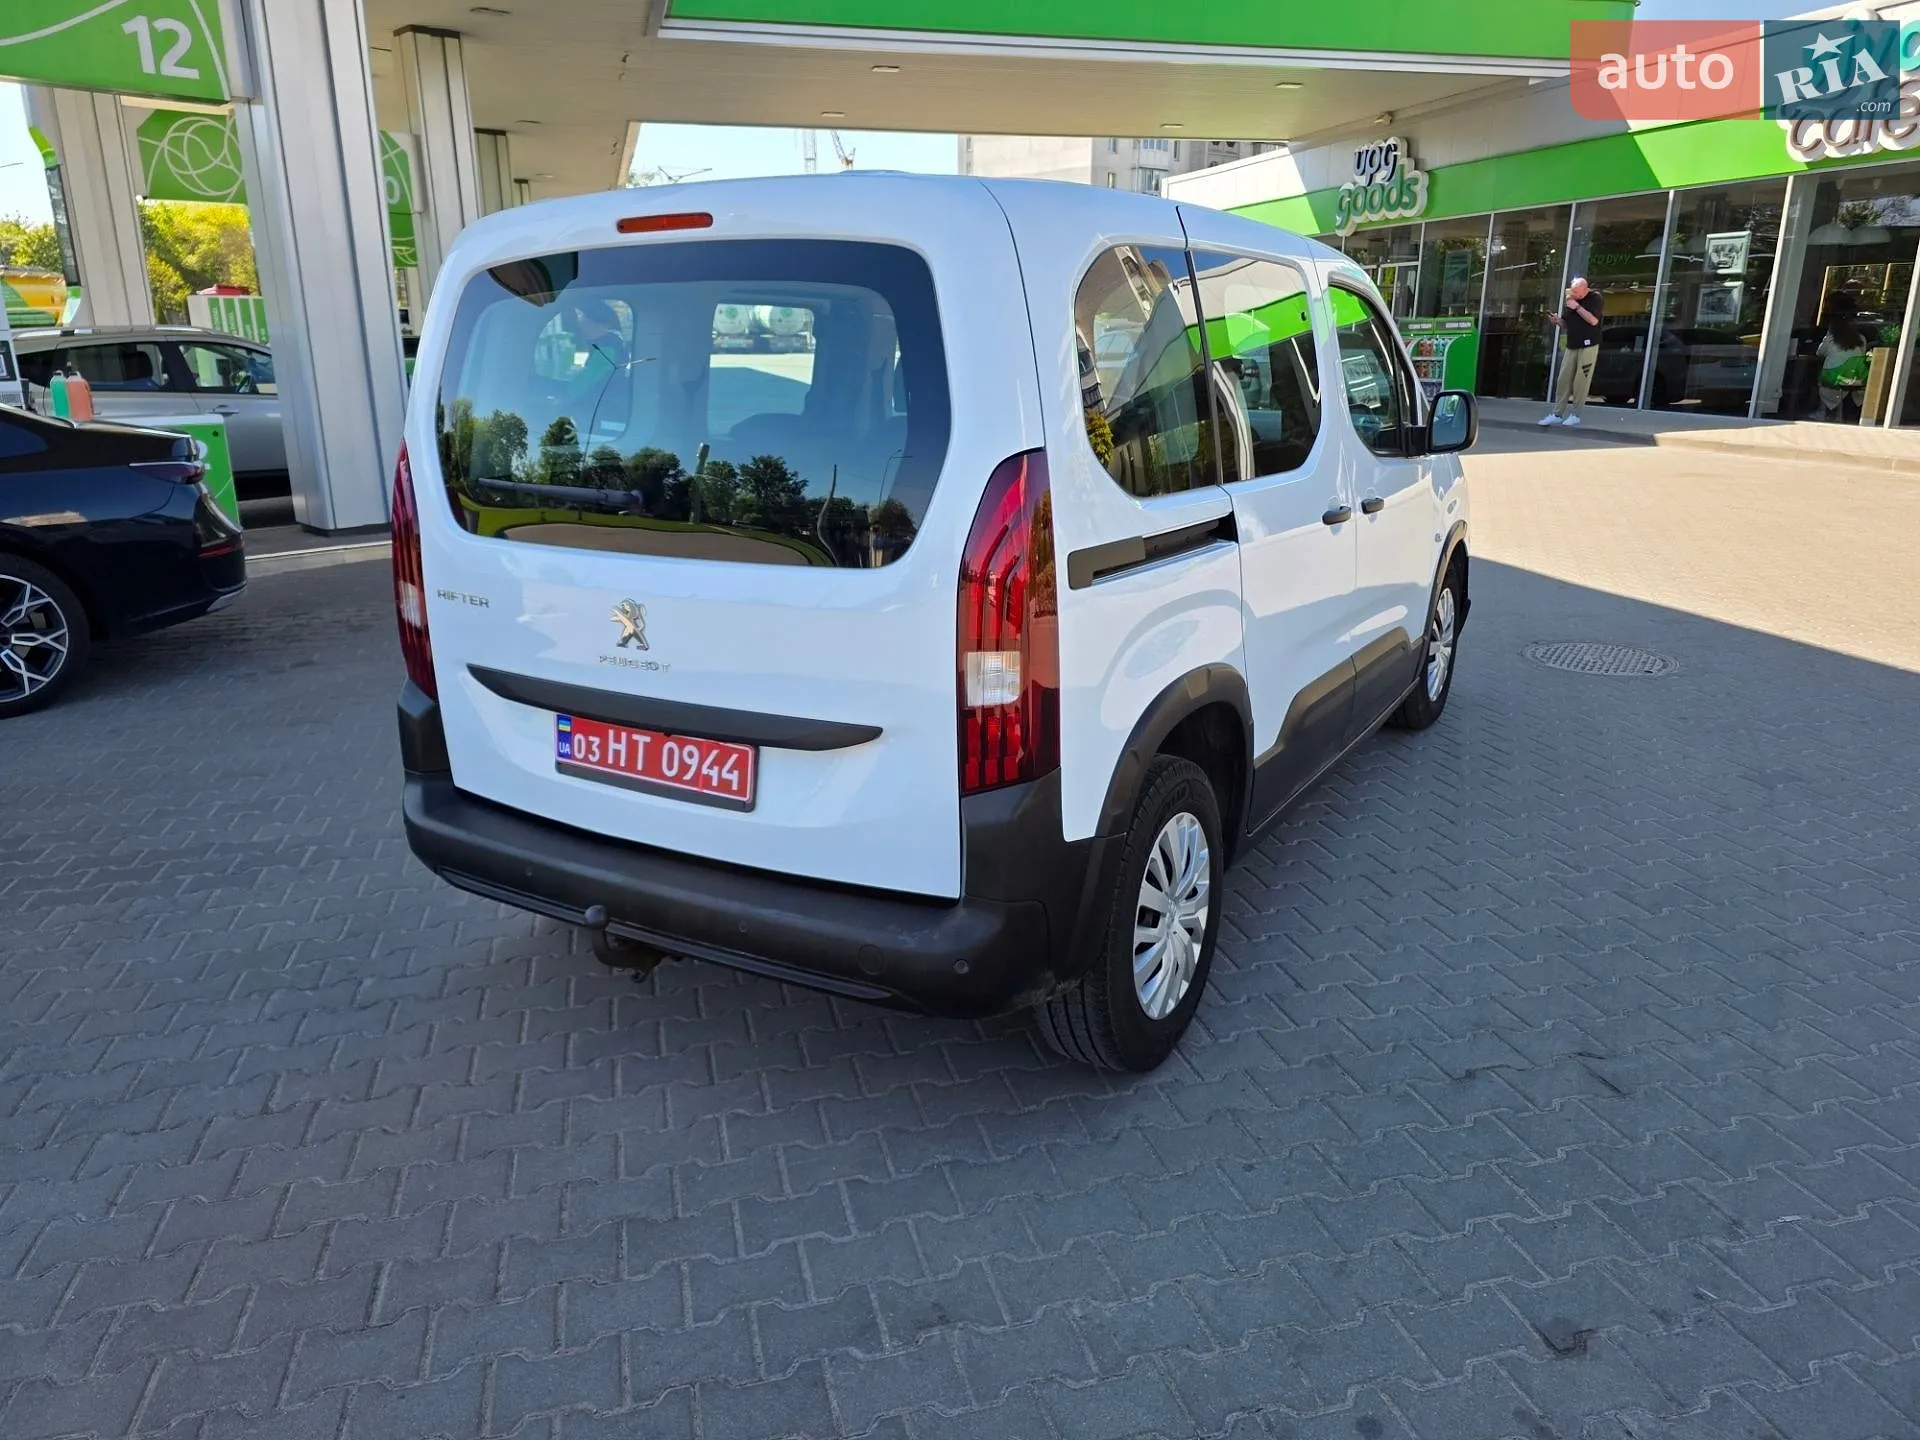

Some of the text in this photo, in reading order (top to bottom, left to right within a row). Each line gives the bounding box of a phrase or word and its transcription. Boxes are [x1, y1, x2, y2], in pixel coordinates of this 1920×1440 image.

[121, 15, 200, 80] 12
[1354, 143, 1398, 187] upg
[1335, 164, 1418, 230] goods
[437, 589, 490, 608] RIFTER
[599, 655, 671, 673] PEUGEOT
[558, 742, 571, 755] UA
[573, 729, 740, 791] 03 HT 0944
